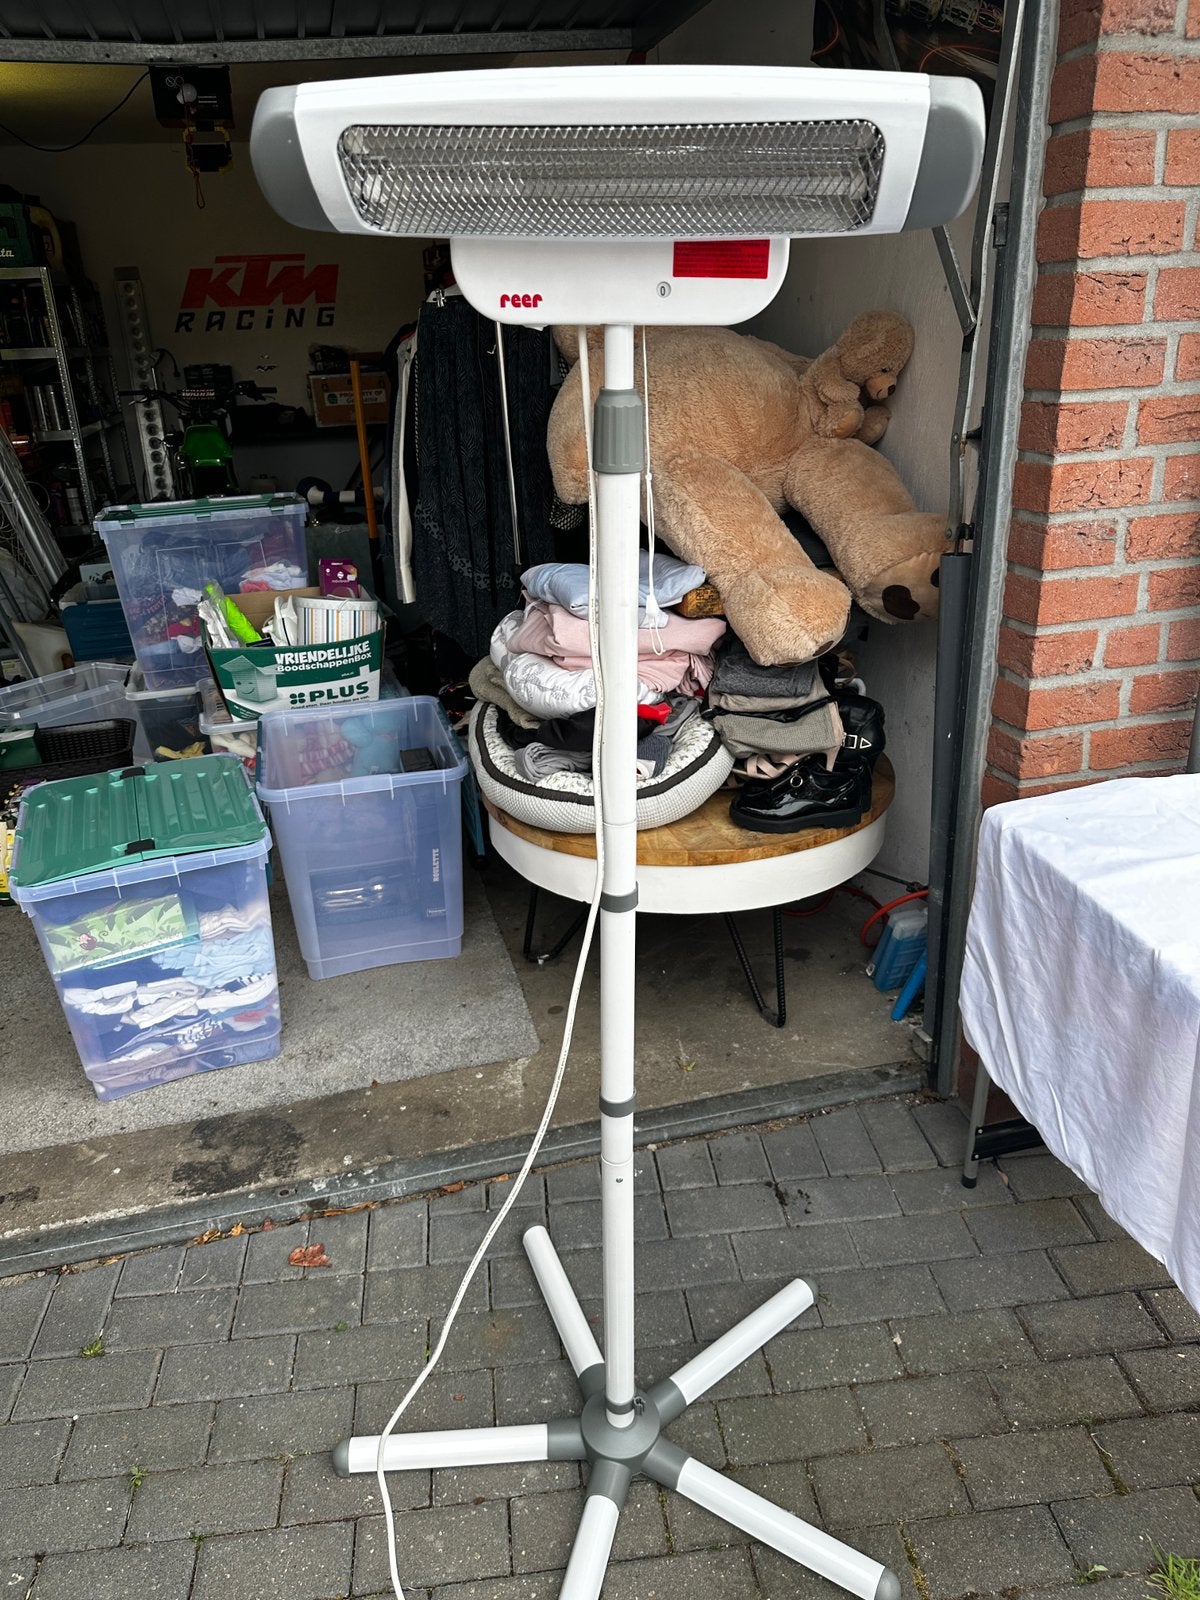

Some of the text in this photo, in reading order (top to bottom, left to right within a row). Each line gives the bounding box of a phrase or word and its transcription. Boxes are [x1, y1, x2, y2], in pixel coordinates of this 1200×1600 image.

[0, 248, 15, 258] ta
[180, 254, 339, 309] KTM
[500, 294, 543, 308] reer
[274, 640, 370, 665] VRIENDELIJKE
[276, 652, 372, 672] BoodschappenBox
[309, 681, 370, 702] PLUS
